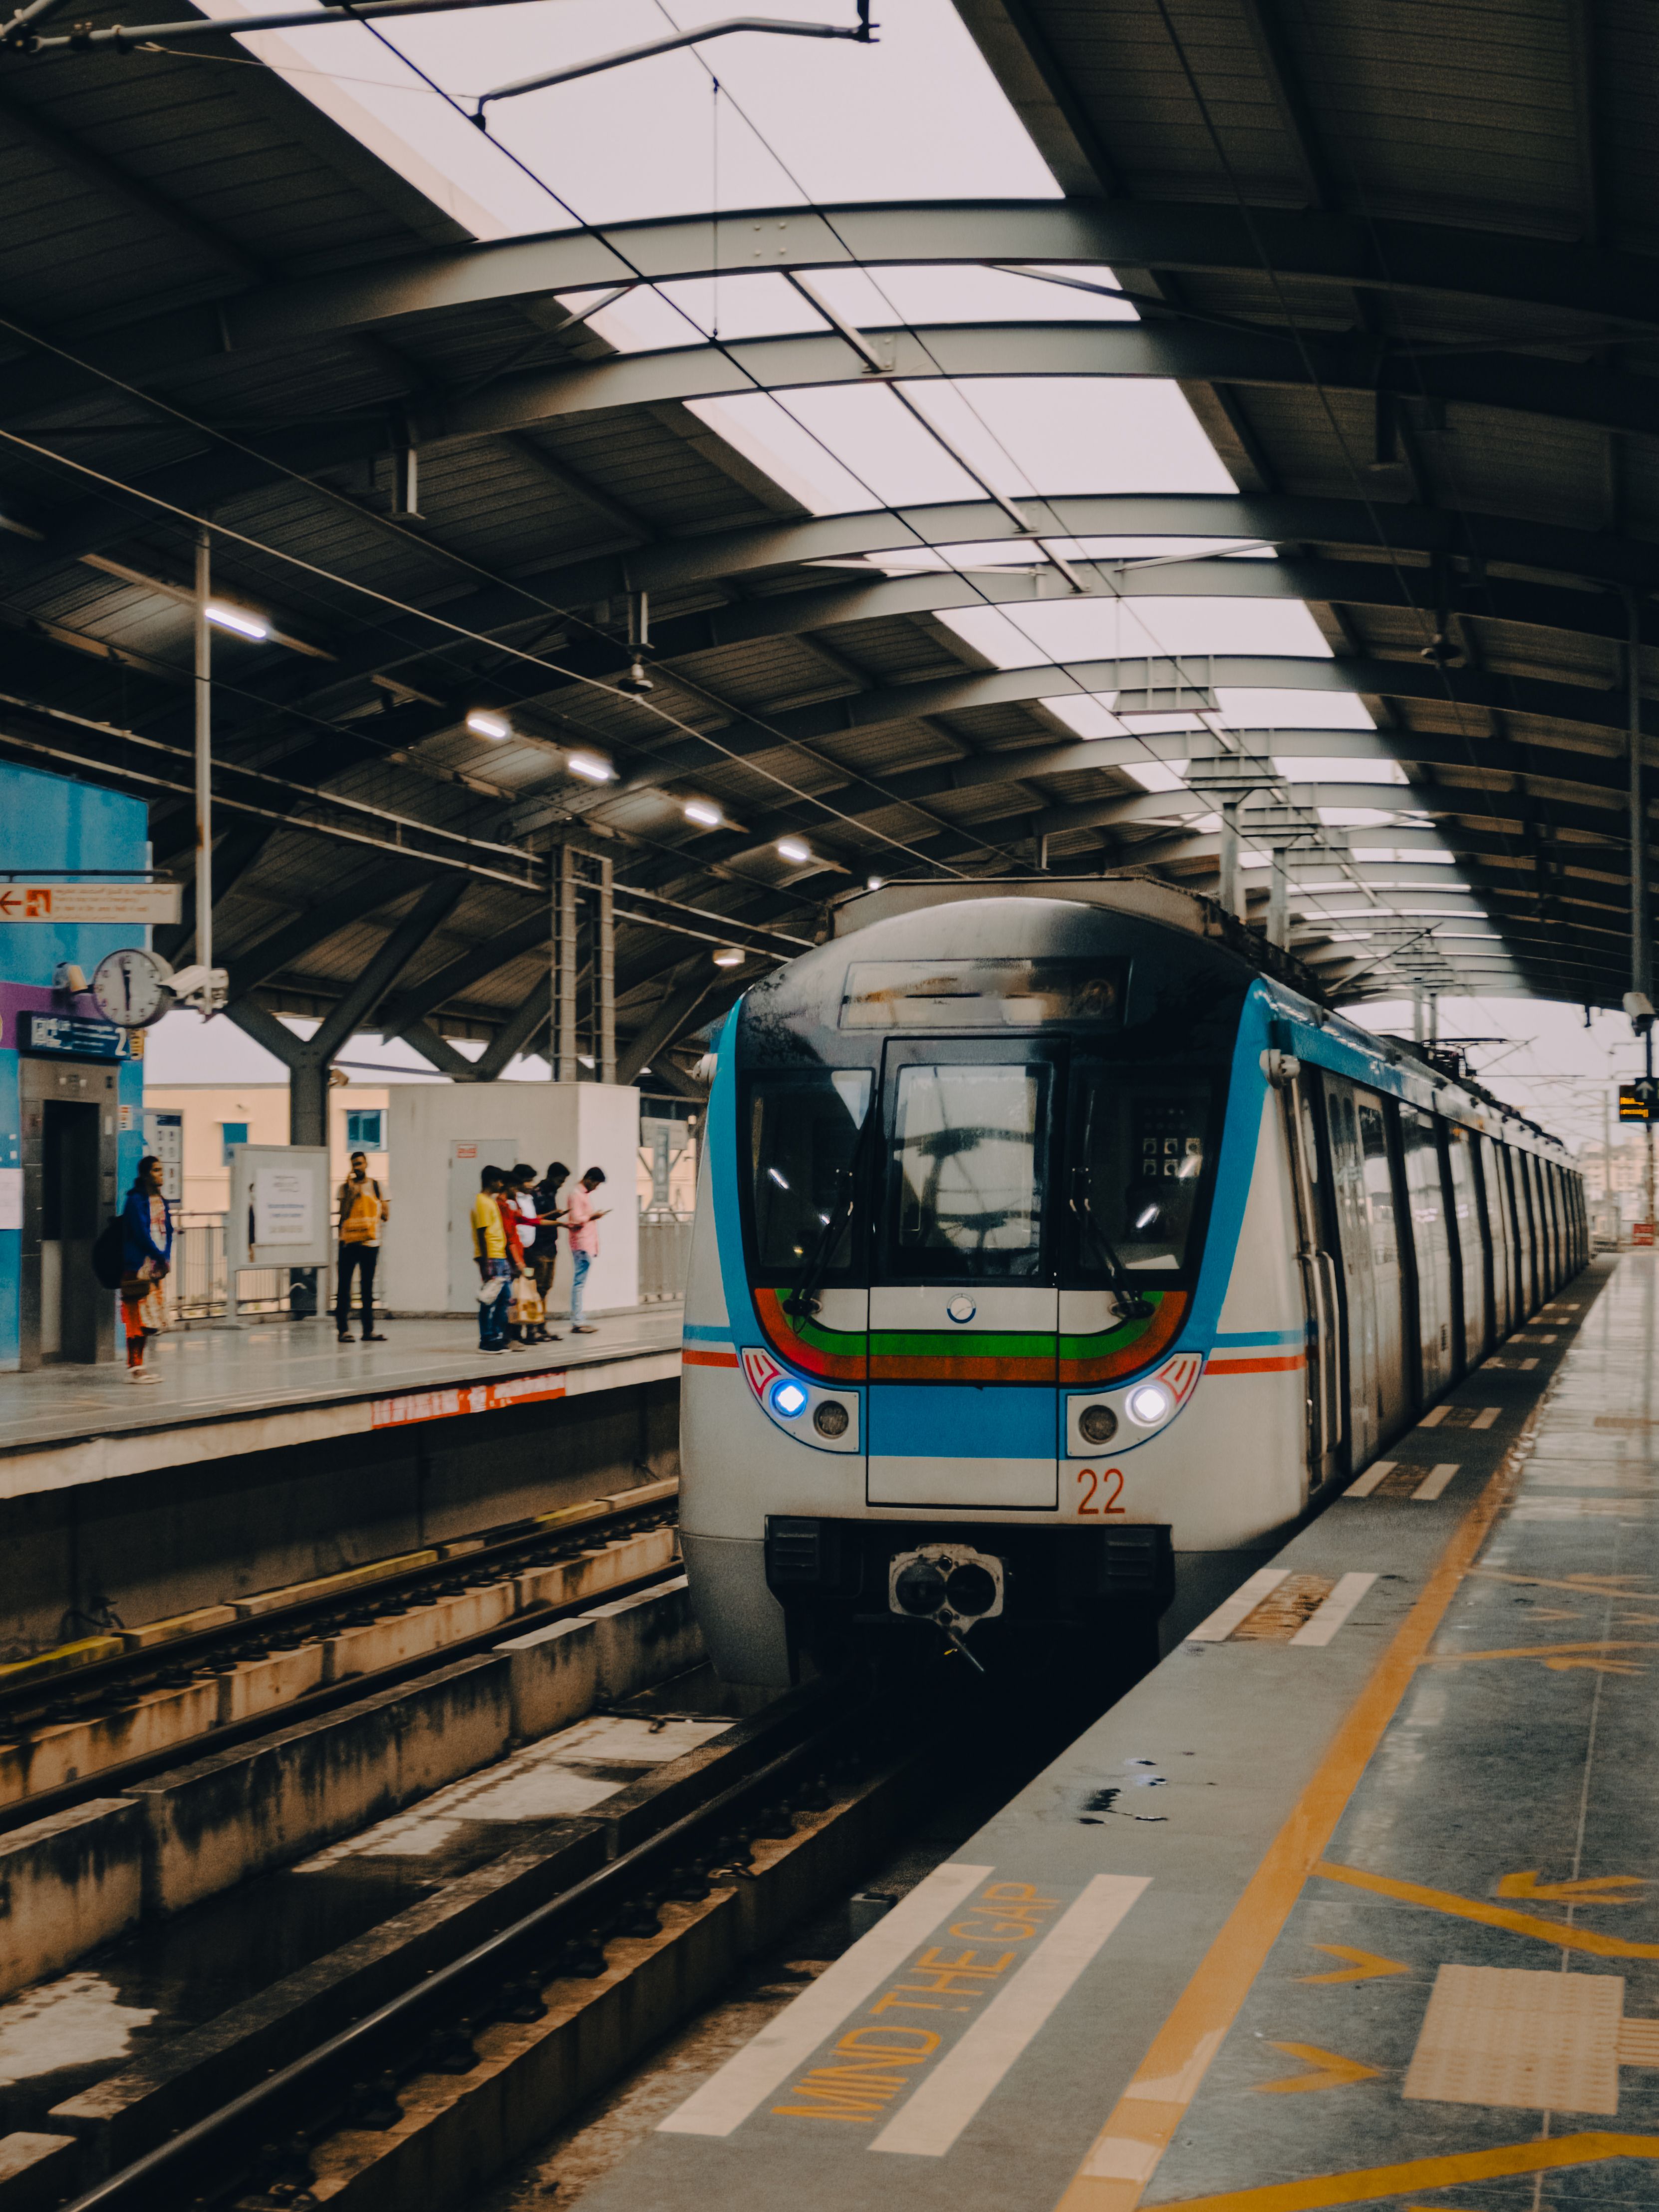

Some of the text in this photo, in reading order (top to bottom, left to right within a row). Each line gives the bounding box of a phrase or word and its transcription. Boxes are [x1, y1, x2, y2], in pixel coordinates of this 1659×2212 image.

[115, 1027, 127, 1056] 2
[1078, 1469, 1125, 1515] 22
[771, 1883, 1061, 2122] MIND THE GAP
